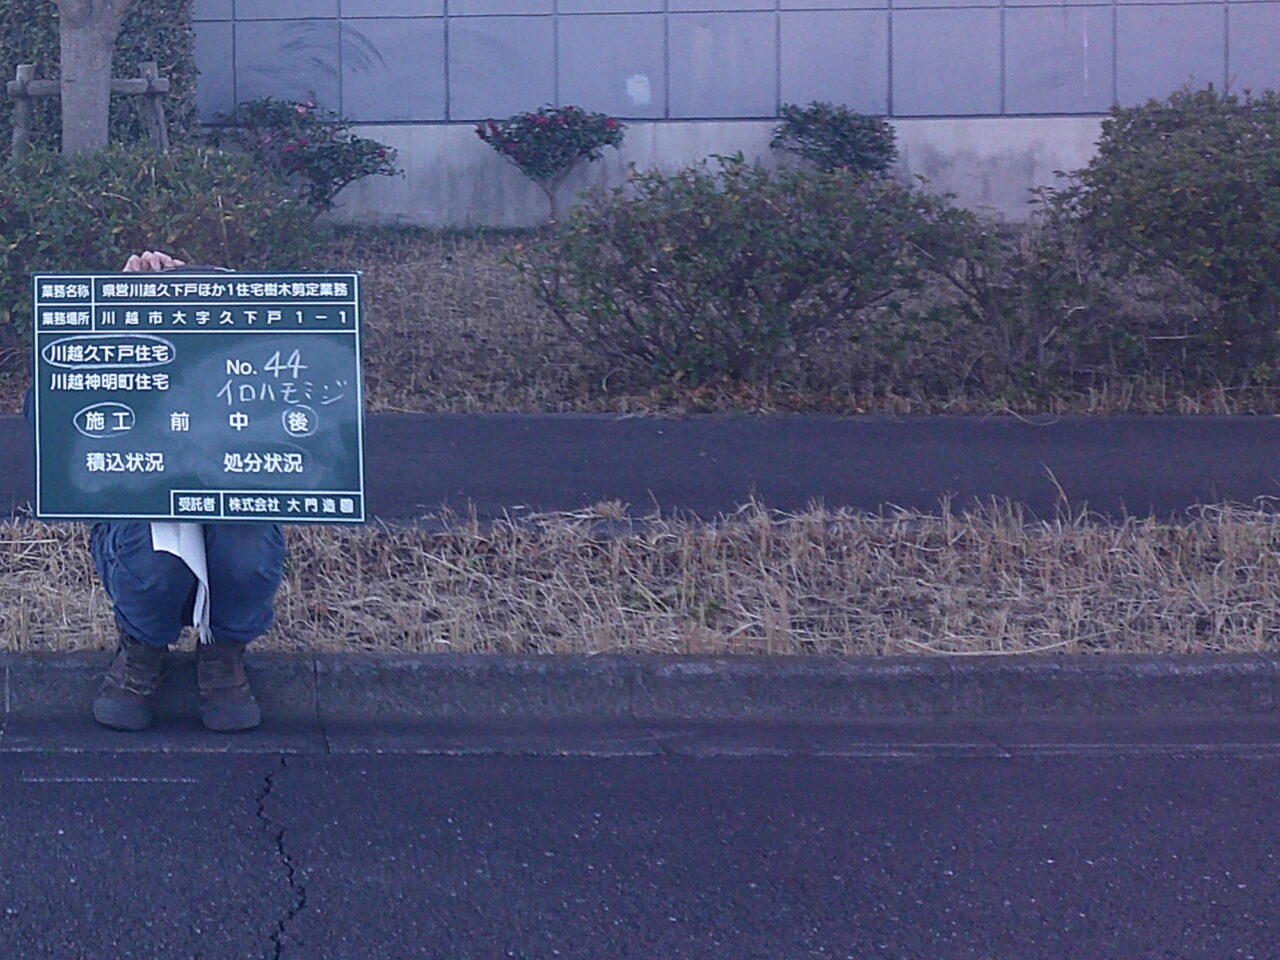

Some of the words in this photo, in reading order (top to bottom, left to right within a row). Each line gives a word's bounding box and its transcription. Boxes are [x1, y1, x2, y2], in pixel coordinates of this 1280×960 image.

[41, 285, 90, 298] 業務名称
[102, 283, 348, 297] 県営川越久下戸ほか1住宅樹木剪定業務
[41, 312, 90, 326] 業務場所
[50, 345, 169, 362] 川越久下戸住宅
[227, 359, 257, 374] No.
[264, 349, 308, 379] 44
[50, 374, 169, 390] 川越神明町住宅
[217, 380, 348, 405] イロハモミジ
[85, 412, 131, 431] 施工
[170, 413, 190, 431] 前
[230, 413, 248, 431] 中
[289, 412, 308, 431] 後
[86, 453, 164, 472] 積込状況
[224, 453, 303, 472] 処分状況
[178, 498, 215, 511] 受託者
